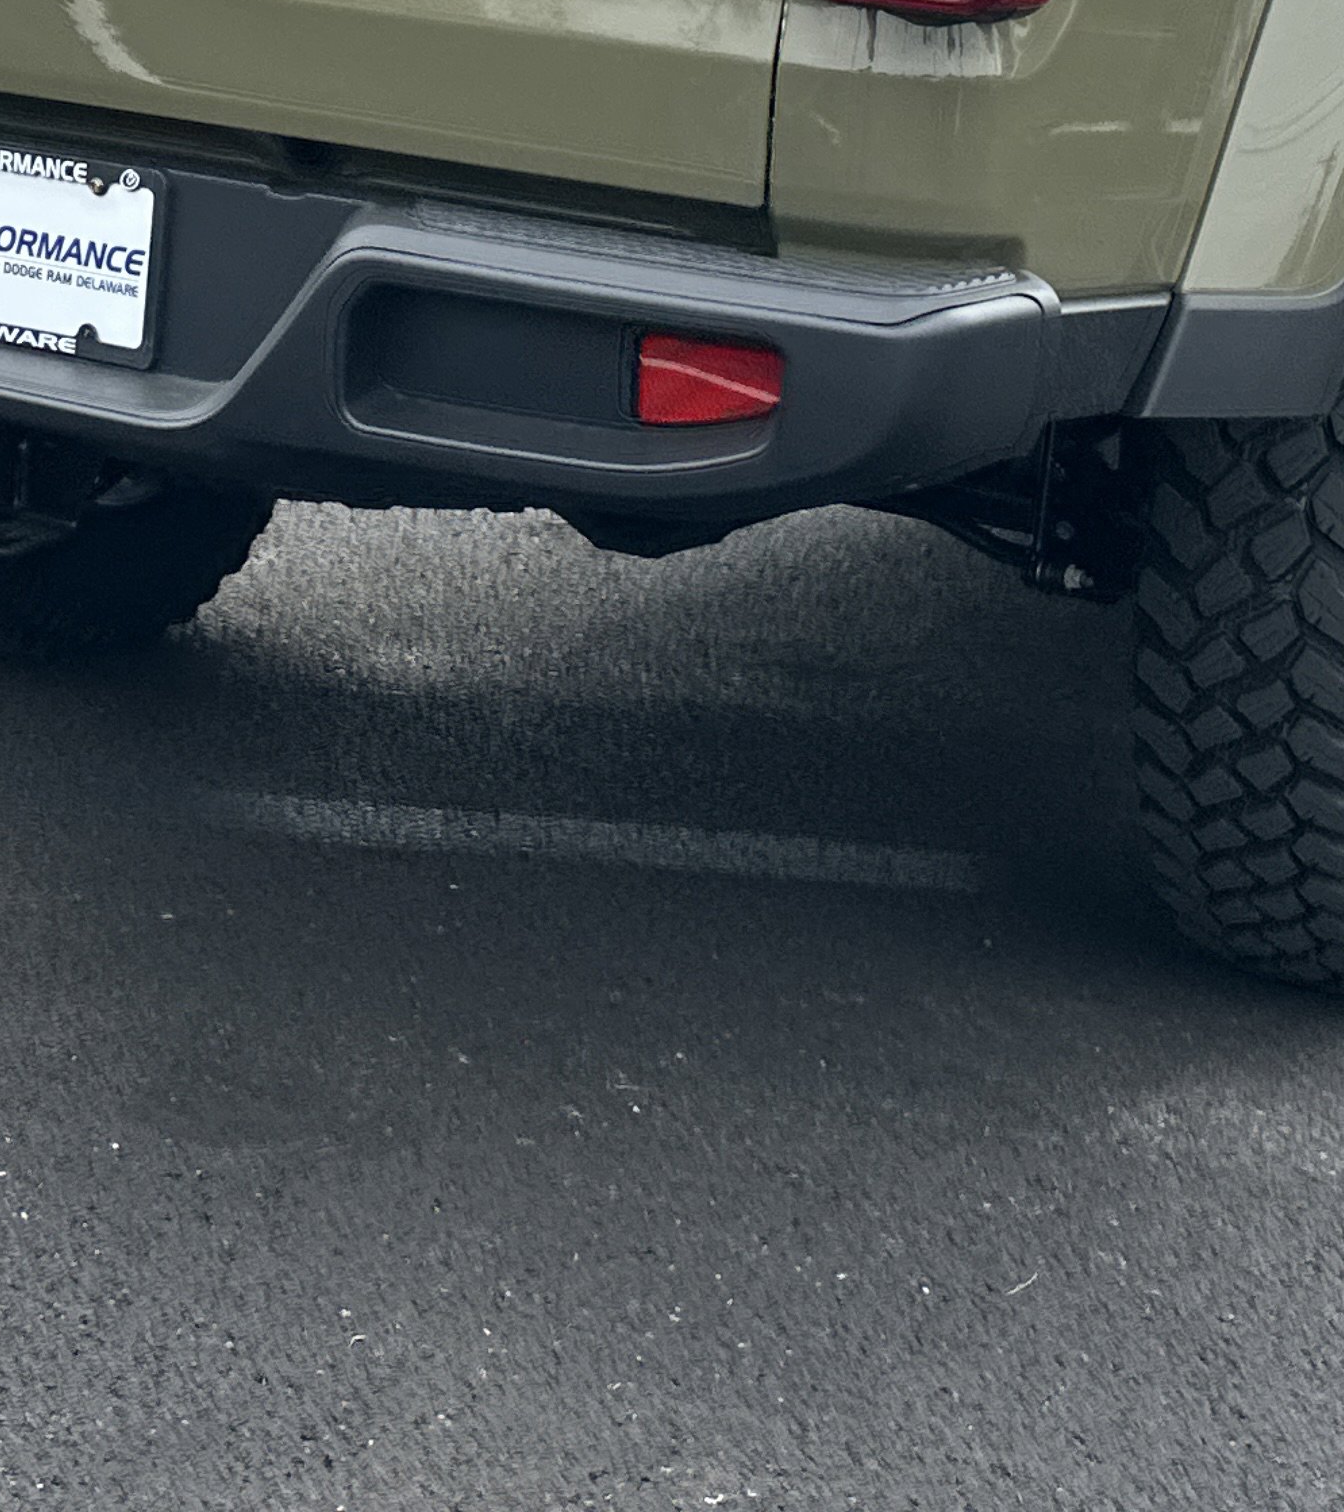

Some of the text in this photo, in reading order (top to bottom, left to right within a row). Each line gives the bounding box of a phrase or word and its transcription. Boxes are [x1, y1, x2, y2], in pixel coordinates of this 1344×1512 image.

[3, 262, 43, 280] DODGE
[46, 269, 73, 285] RAM
[76, 275, 139, 298] DELAWARE
